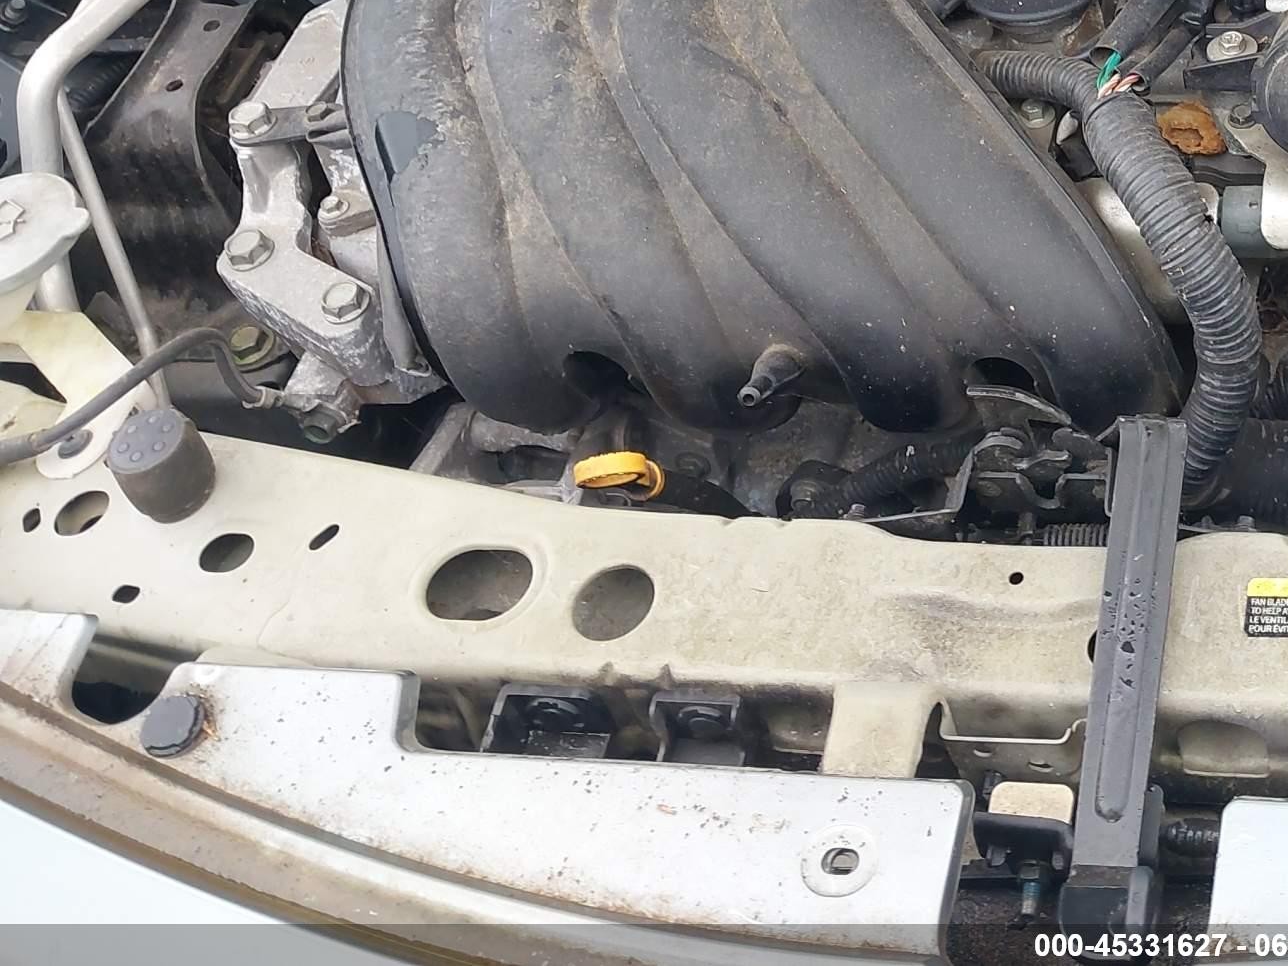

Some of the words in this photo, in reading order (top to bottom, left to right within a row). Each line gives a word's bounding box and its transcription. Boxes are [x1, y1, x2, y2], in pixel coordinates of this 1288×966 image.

[1251, 597, 1266, 606] FAN
[1251, 606, 1261, 615] TO
[1262, 607, 1281, 615] HELP
[1250, 615, 1258, 624] LE
[1249, 624, 1272, 633] POUR
